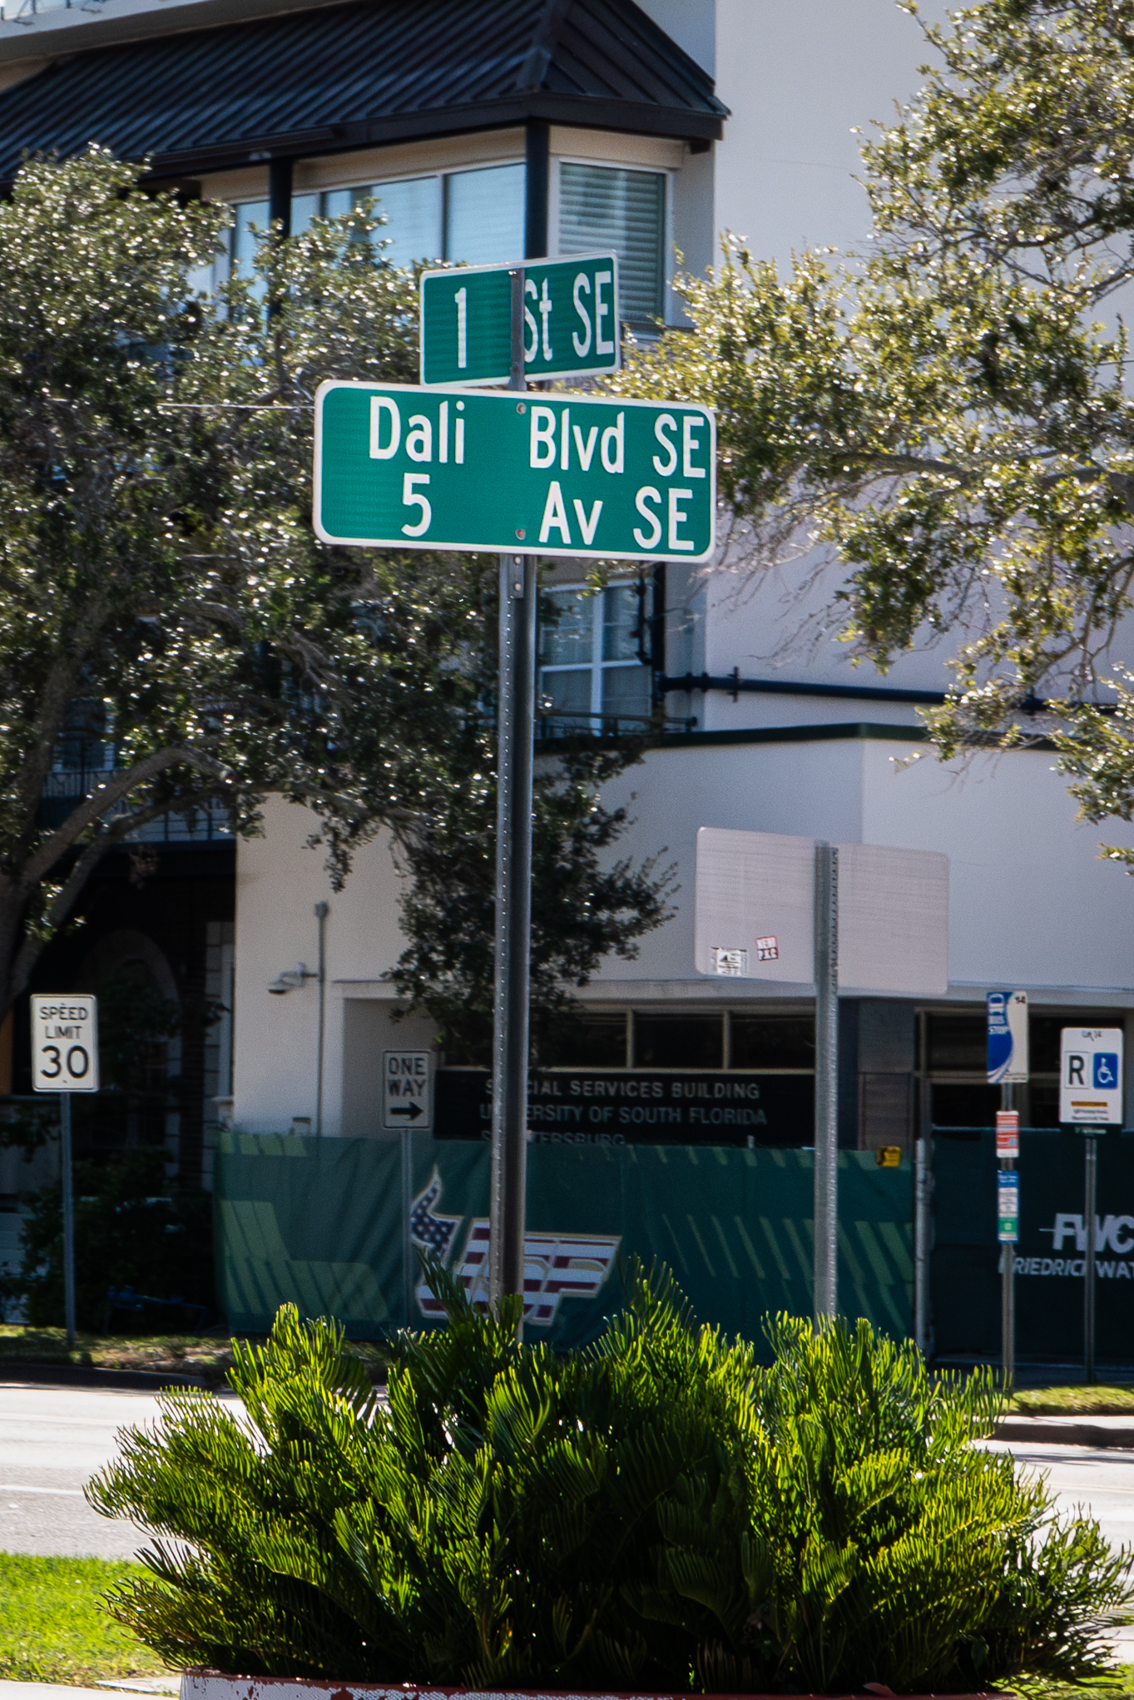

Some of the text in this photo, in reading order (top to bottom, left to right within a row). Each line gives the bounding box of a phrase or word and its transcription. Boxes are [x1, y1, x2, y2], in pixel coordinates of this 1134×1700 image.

[454, 270, 615, 369] 1 St SE
[369, 395, 706, 479] Dali Blvd SE
[401, 472, 695, 551] 5 Av SE
[40, 1006, 88, 1020] SPEED
[45, 1025, 83, 1039] LIMIT
[41, 1045, 89, 1079] 30
[388, 1056, 426, 1076] ONE
[1068, 1054, 1085, 1085] R
[387, 1079, 427, 1097] WAY
[569, 1080, 664, 1098] SERVICES
[671, 1082, 761, 1099] BUILDING
[588, 1106, 612, 1123] OF
[618, 1106, 681, 1125] SOUTH
[688, 1107, 768, 1126] FLORIDA
